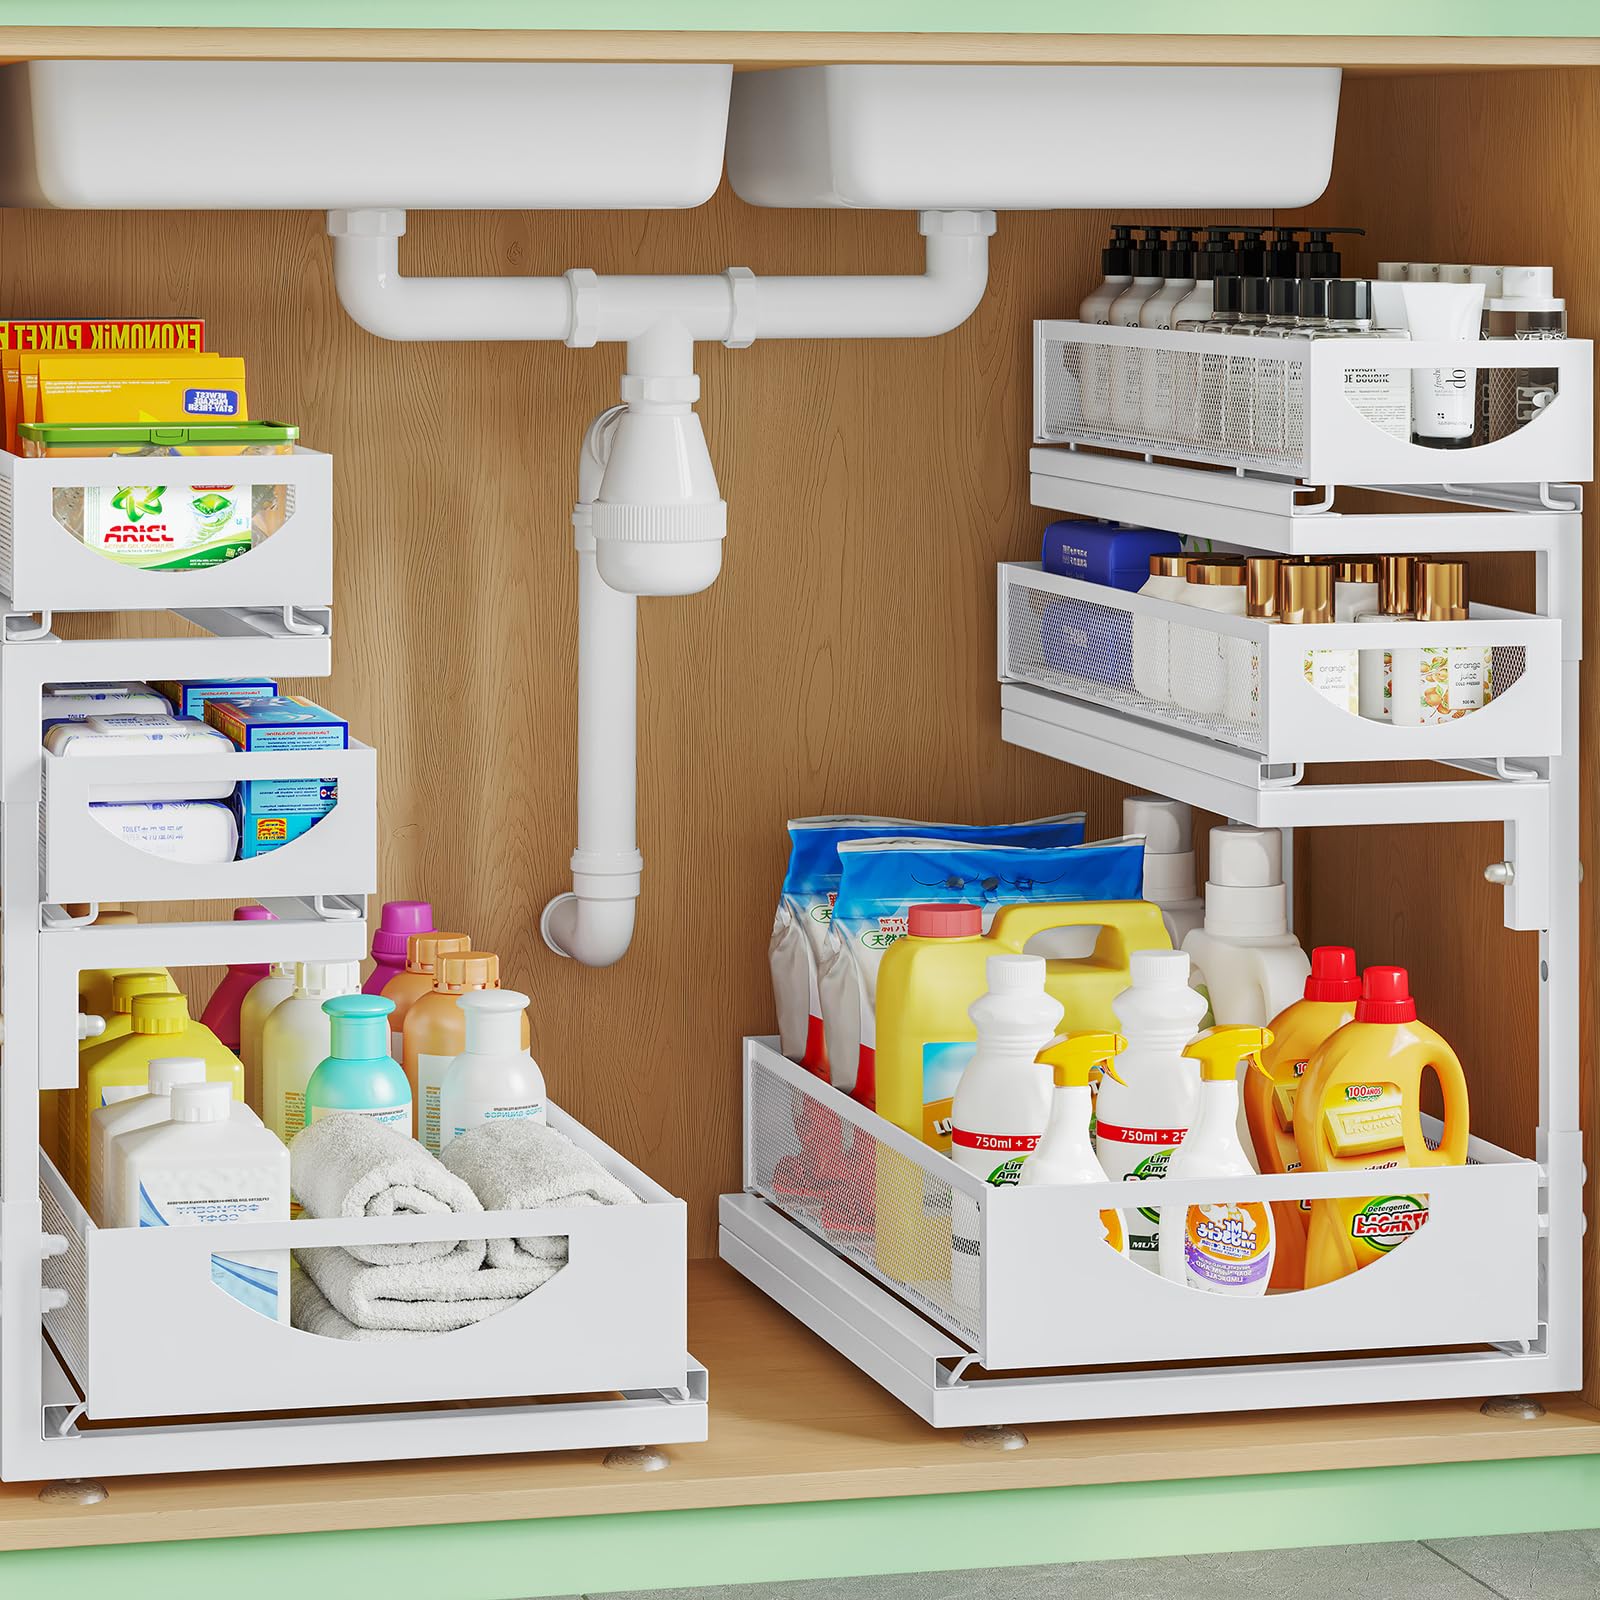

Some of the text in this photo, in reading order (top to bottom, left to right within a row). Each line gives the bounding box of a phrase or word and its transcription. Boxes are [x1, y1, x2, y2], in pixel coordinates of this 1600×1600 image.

[1355, 374, 1390, 384] DOUCHE
[1454, 662, 1481, 670] orange
[871, 933, 907, 946] 天然
[1348, 1086, 1367, 1097] 100
[1121, 1130, 1158, 1142] 750ml
[975, 1136, 1012, 1149] 750ml
[1367, 1203, 1411, 1213] Detergente
[1132, 1241, 1158, 1249] MUY
